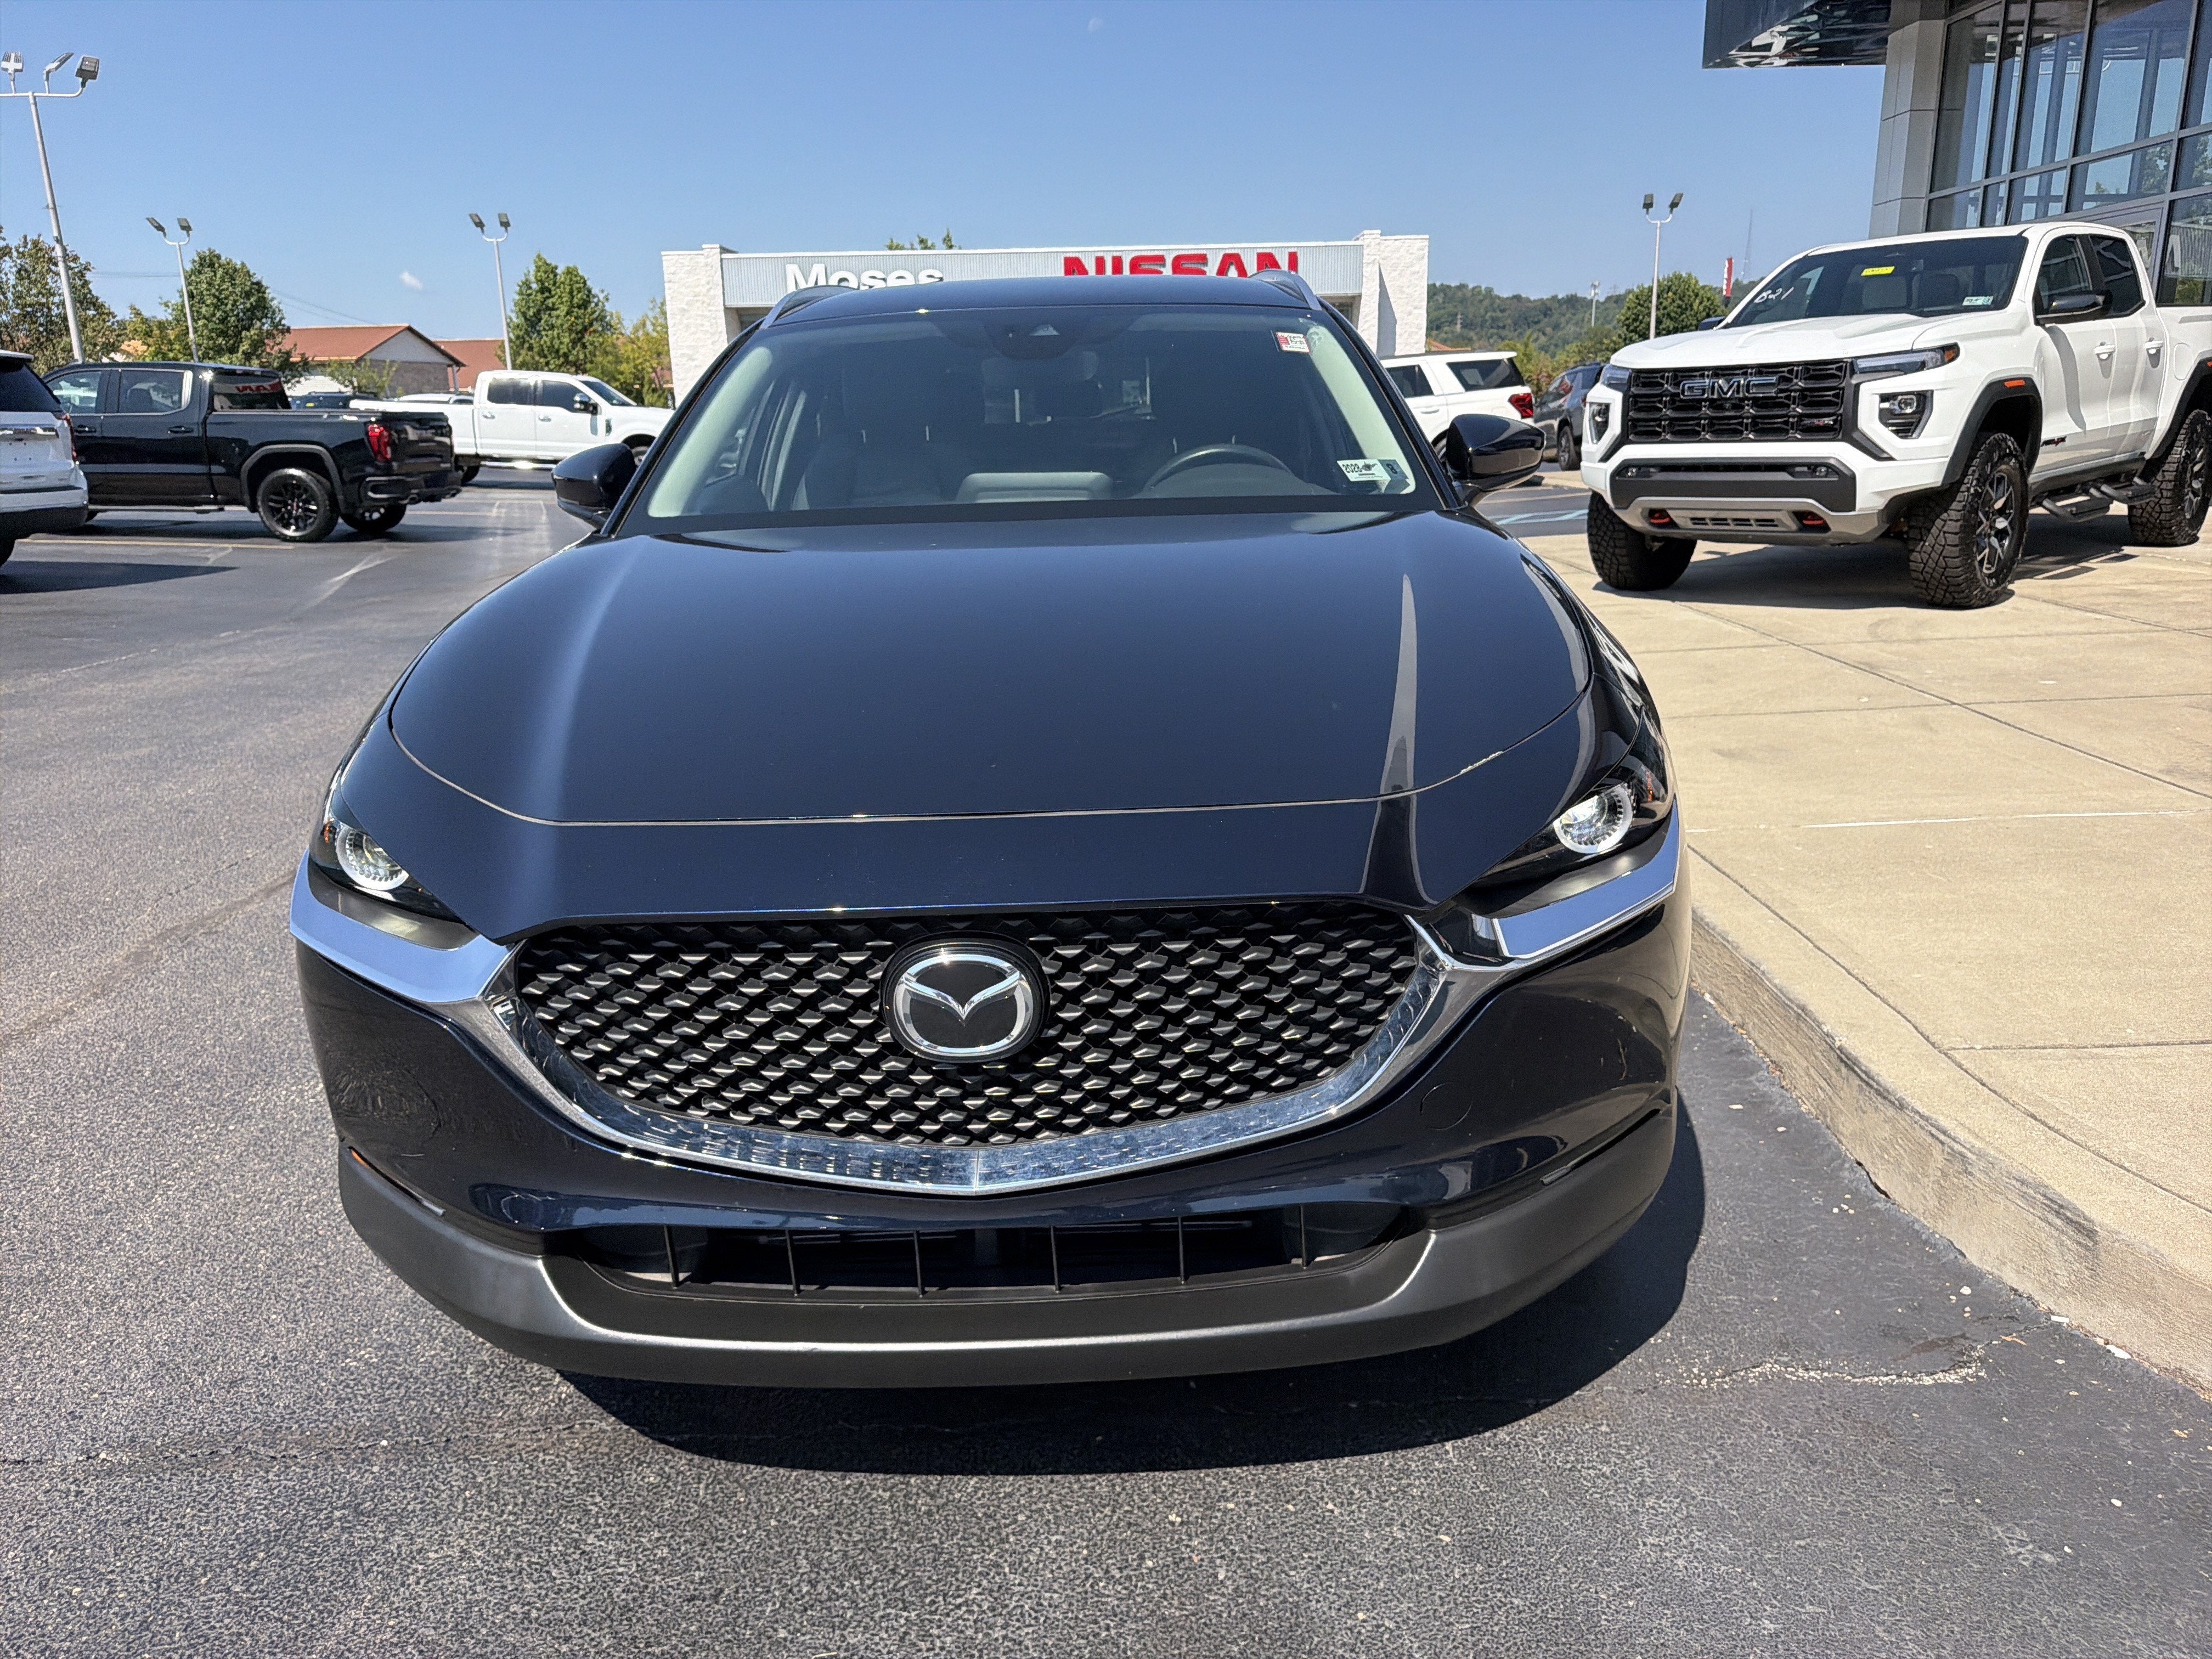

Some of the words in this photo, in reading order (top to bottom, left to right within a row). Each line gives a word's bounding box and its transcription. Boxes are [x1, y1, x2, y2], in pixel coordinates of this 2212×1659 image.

[1064, 251, 1298, 276] NISSAN
[785, 263, 944, 293] Moses
[1680, 376, 1779, 399] GMC
